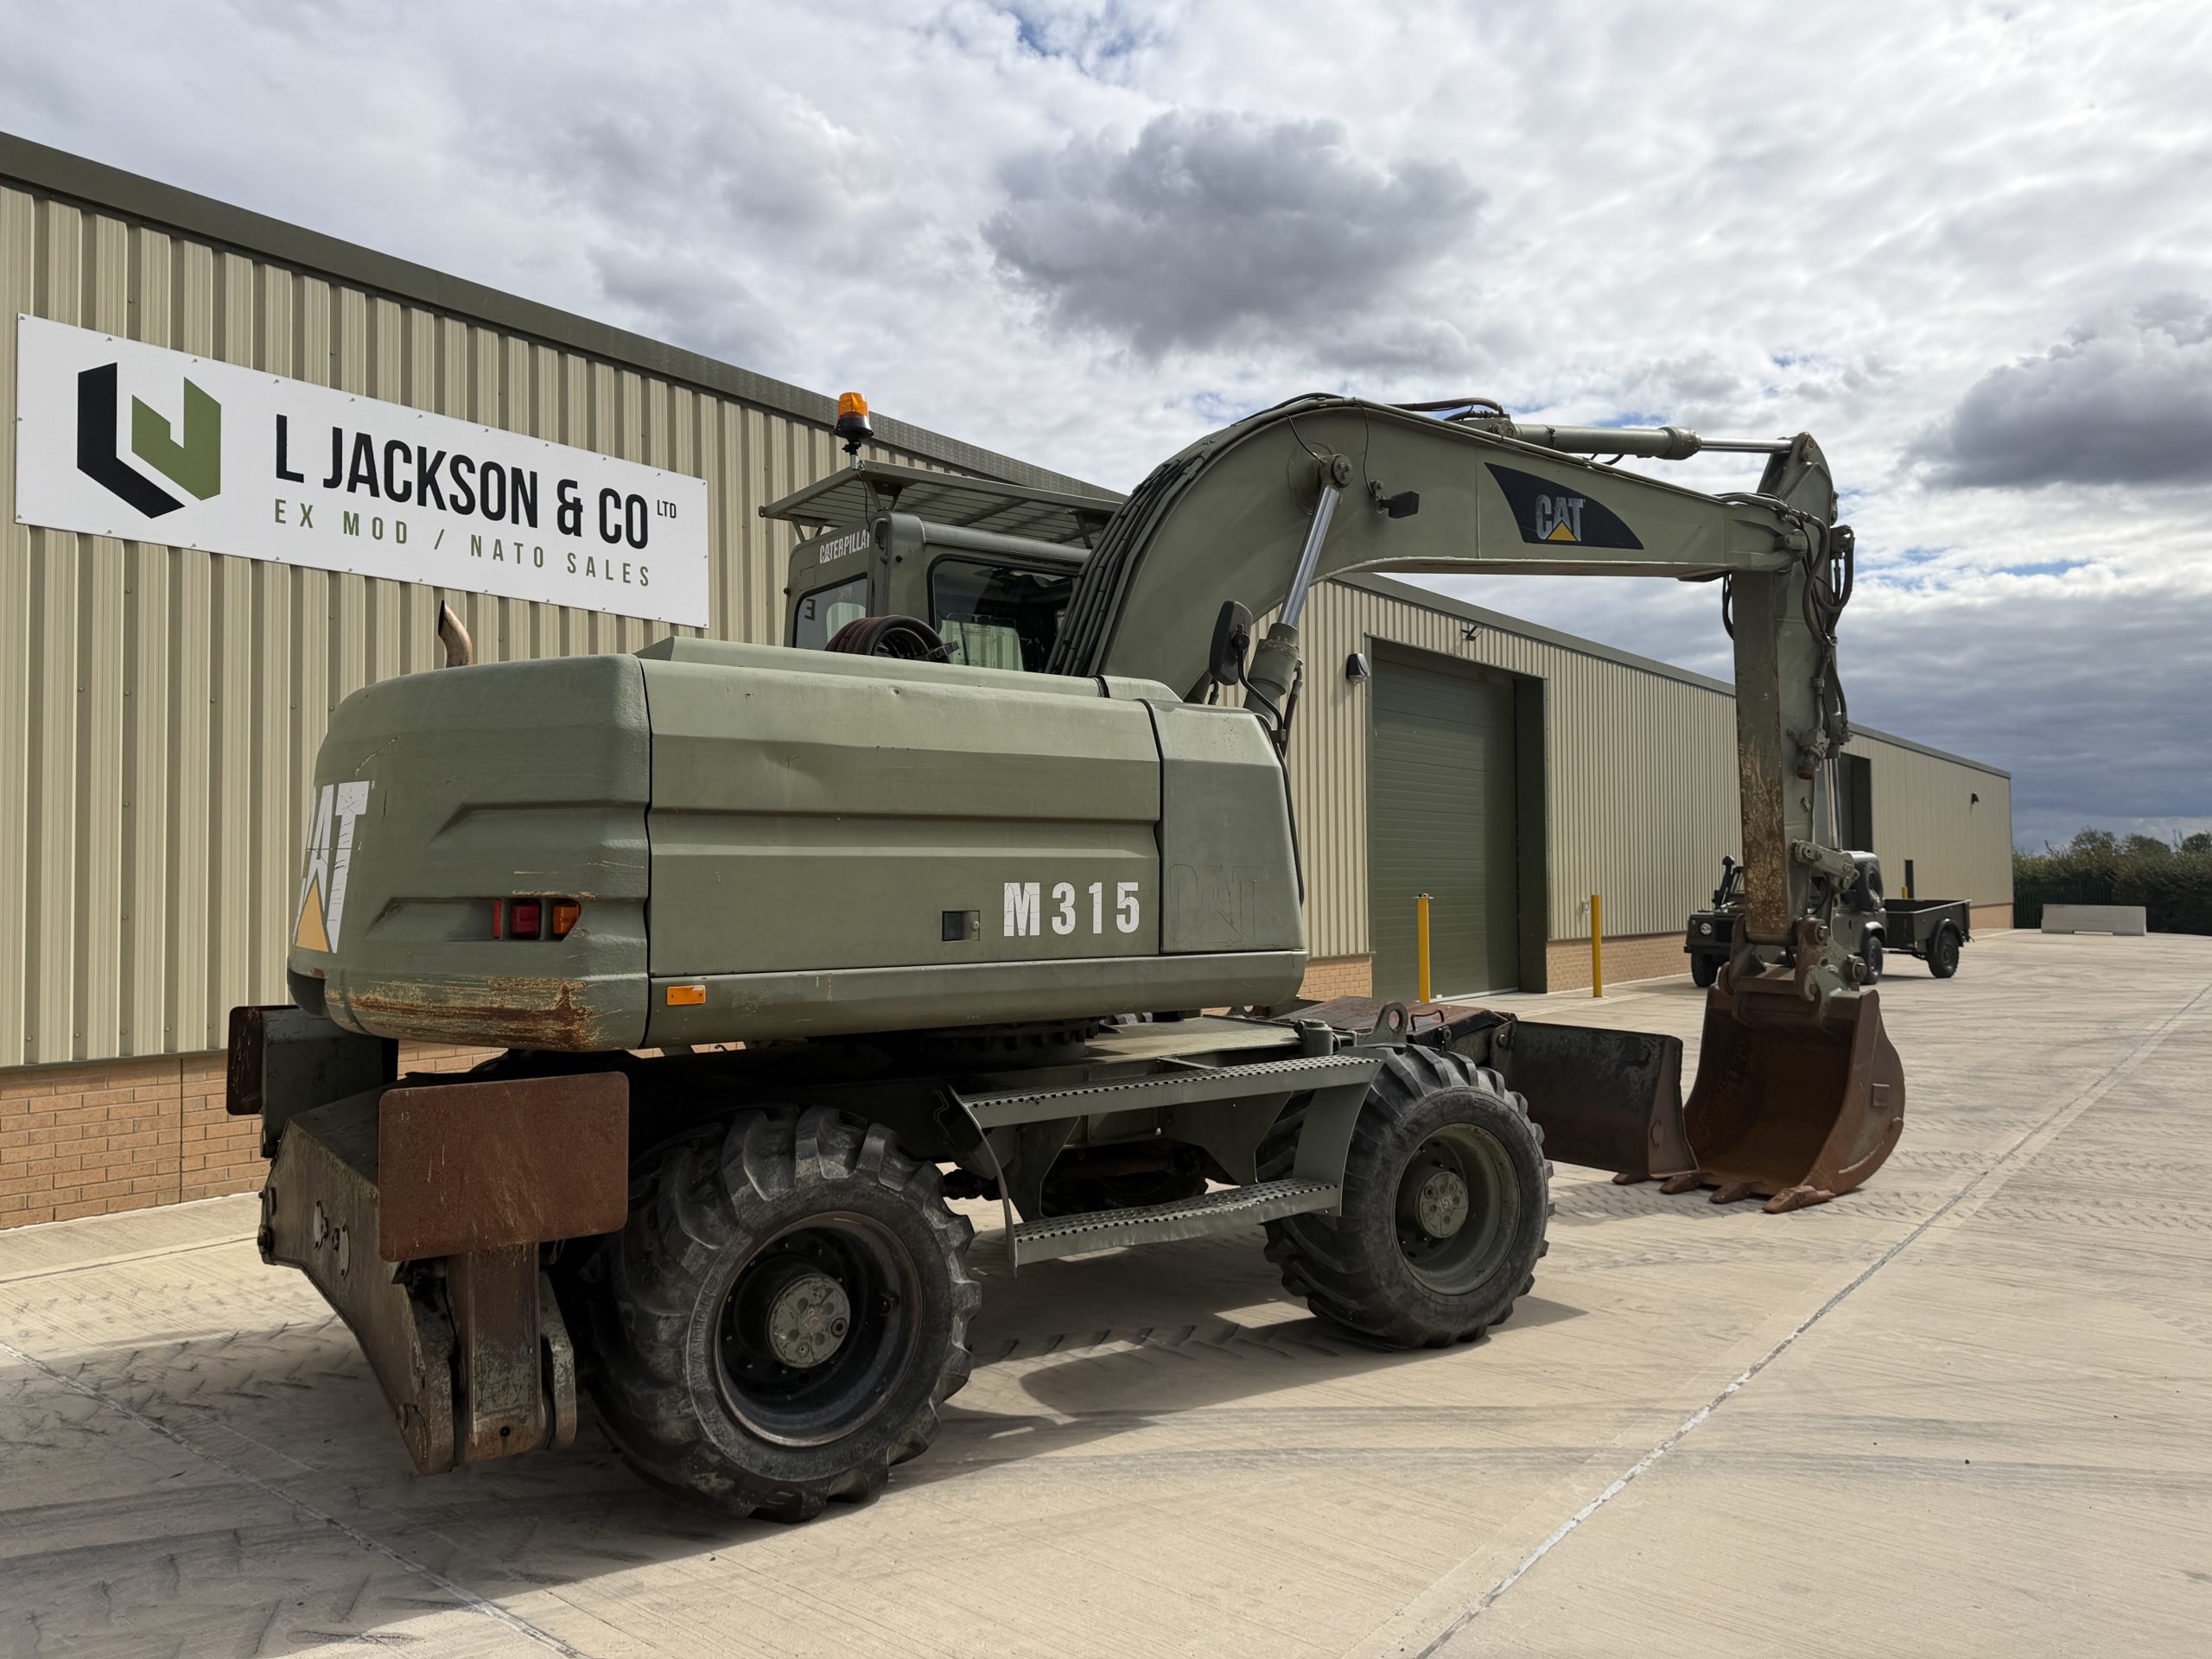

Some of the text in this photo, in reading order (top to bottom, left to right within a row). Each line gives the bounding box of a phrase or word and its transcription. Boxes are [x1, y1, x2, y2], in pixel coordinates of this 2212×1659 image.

[276, 413, 677, 550] L JACKSON & CO LTD
[1535, 494, 1585, 542] CAT
[275, 499, 649, 587] EX MOD / NATO SALES
[292, 780, 371, 954] AT
